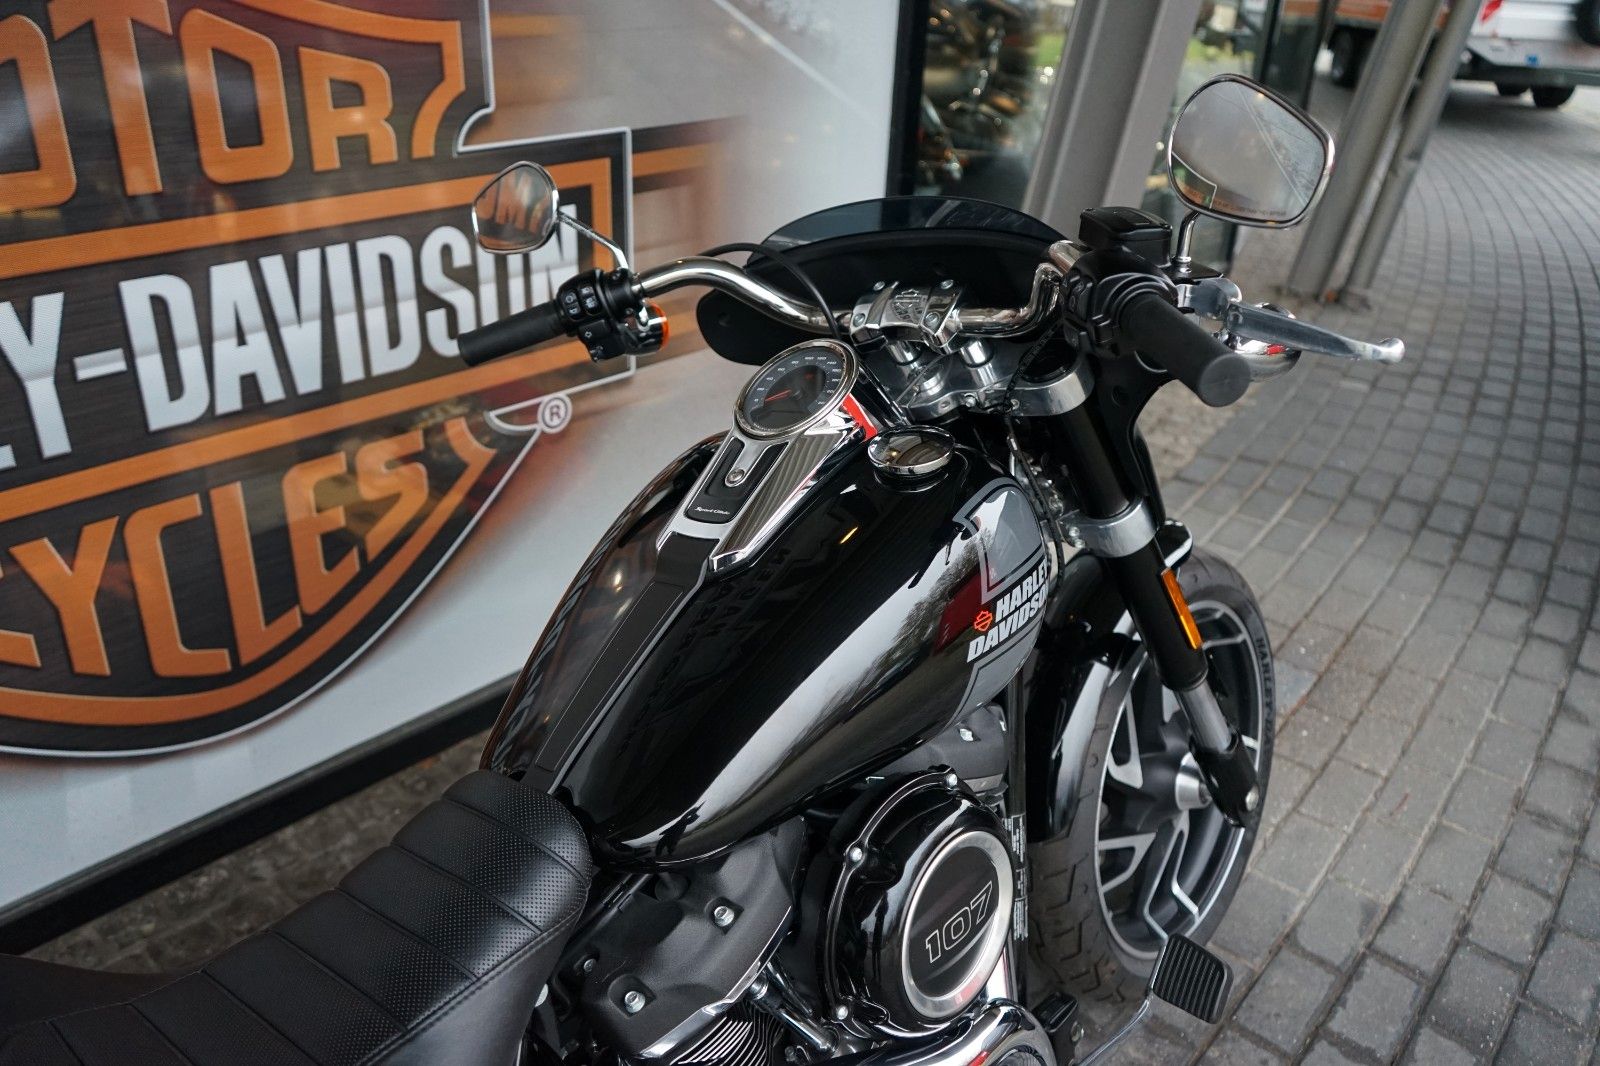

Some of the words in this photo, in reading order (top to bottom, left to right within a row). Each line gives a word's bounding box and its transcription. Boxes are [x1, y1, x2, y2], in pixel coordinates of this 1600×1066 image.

[0, 204, 578, 470] Y-DAVIDSON
[0, 429, 428, 677] YCLES
[926, 880, 993, 964] 107
